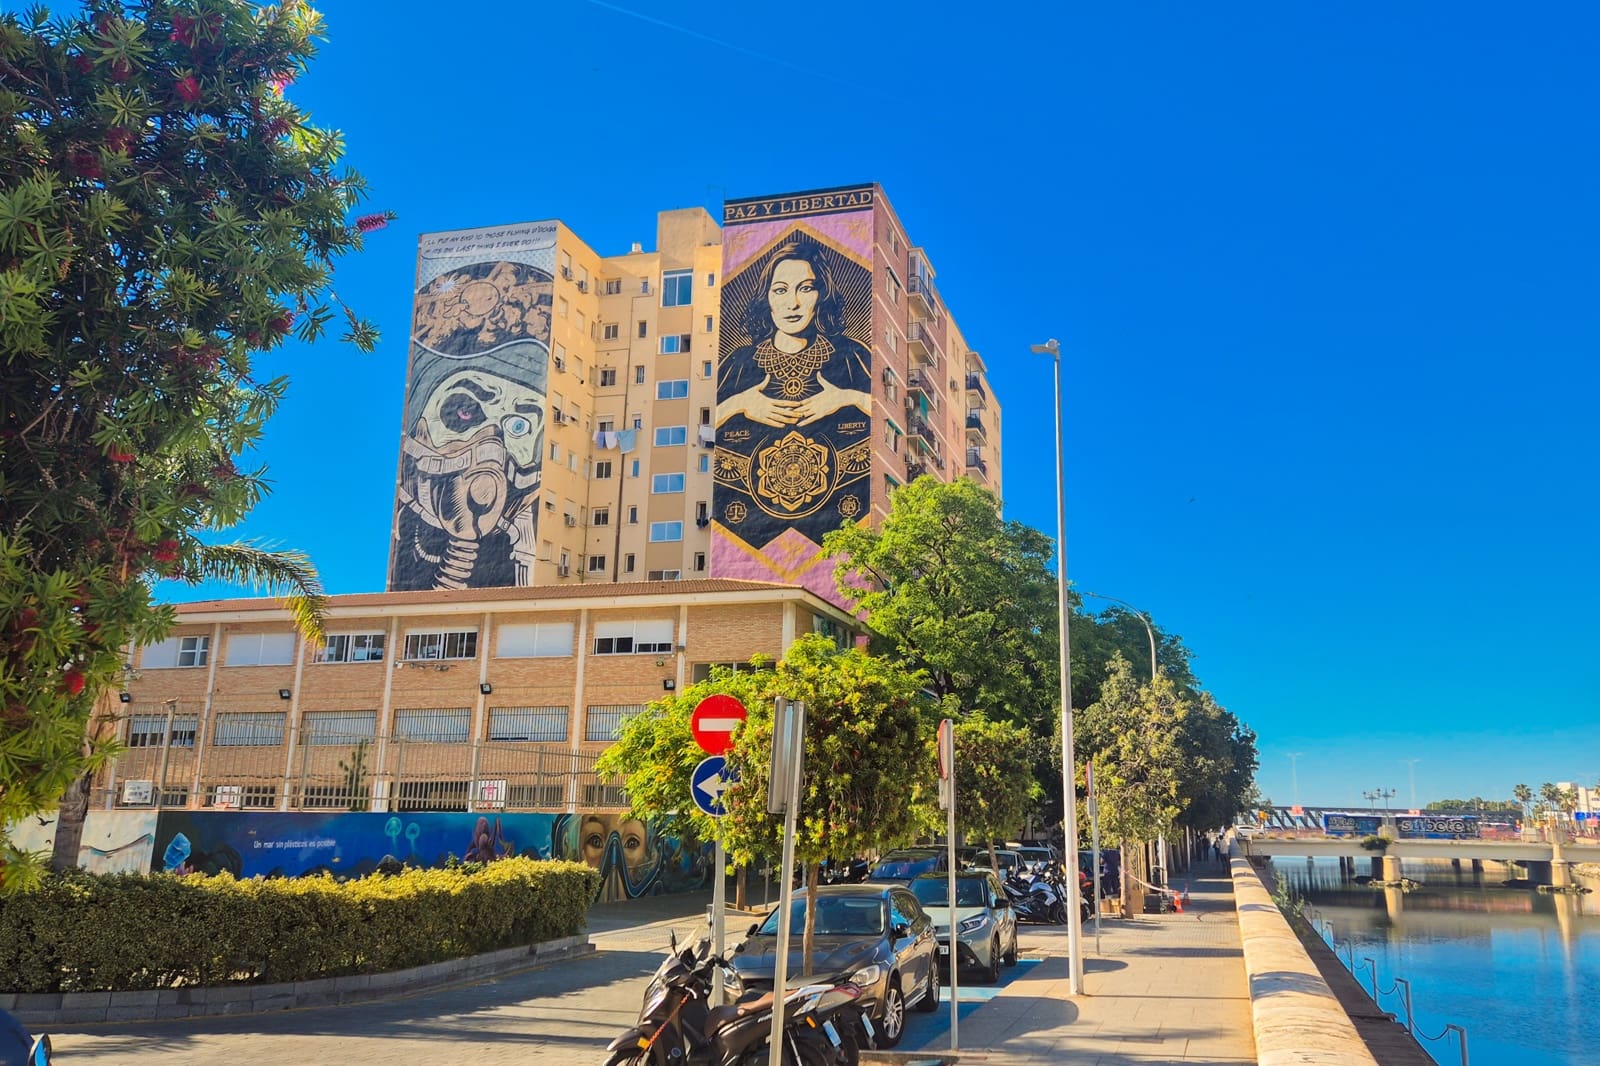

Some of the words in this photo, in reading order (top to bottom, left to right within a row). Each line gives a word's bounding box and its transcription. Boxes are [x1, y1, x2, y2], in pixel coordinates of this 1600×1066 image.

[725, 205, 757, 220] PAZ
[763, 203, 775, 215] Y
[780, 191, 872, 213] LIBERTAD
[459, 233, 474, 241] END
[484, 230, 505, 239] THOSE
[506, 227, 530, 236] FLYING
[455, 243, 476, 252] LAST
[501, 239, 520, 247] EVER
[837, 421, 866, 430] LIBERTY
[724, 429, 750, 438] PEACE
[253, 840, 262, 849] Un
[263, 841, 273, 849] mar
[275, 840, 283, 848] sin
[308, 840, 316, 848] es
